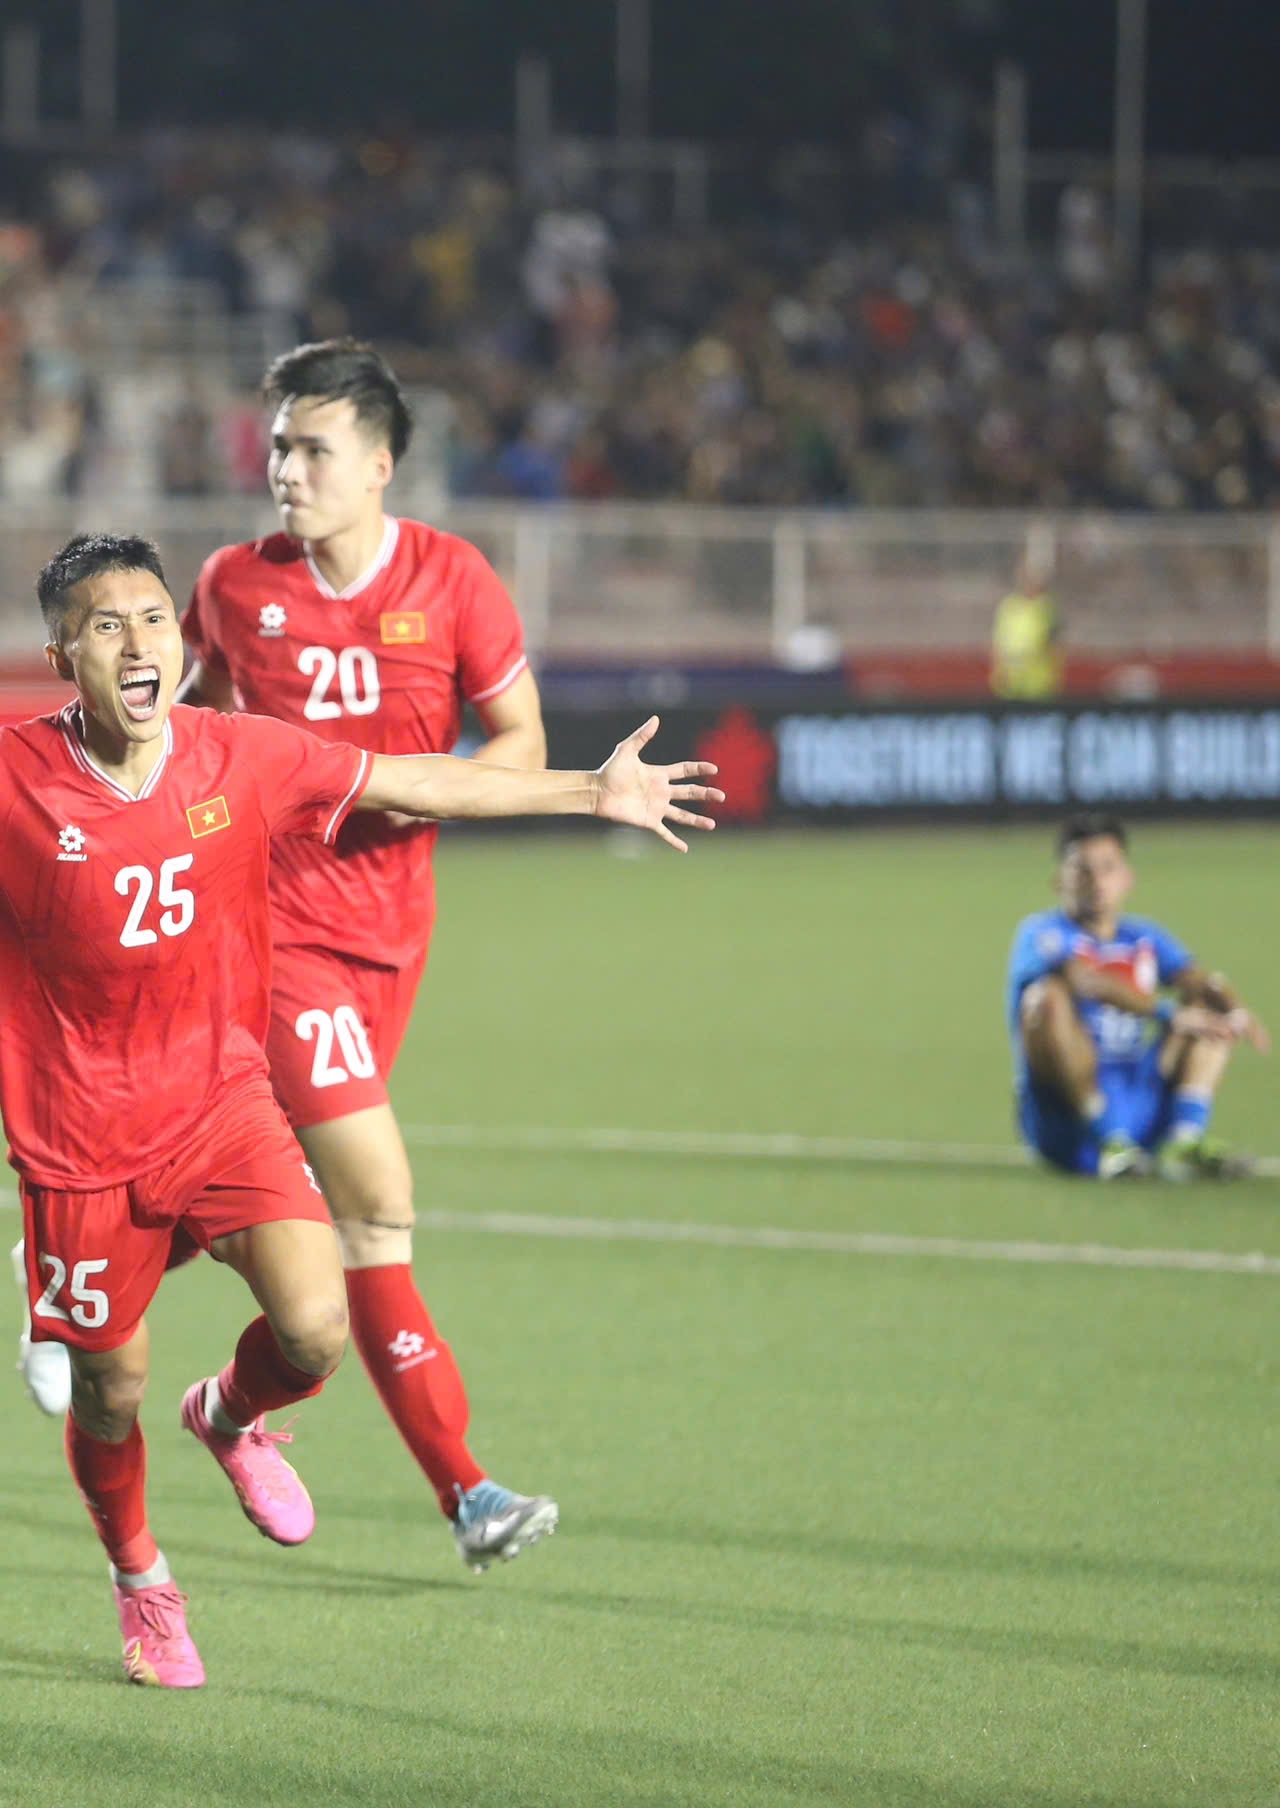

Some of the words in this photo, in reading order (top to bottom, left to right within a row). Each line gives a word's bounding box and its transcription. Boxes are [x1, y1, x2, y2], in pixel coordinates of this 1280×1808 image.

[297, 646, 381, 721] 20
[778, 714, 995, 804] TOGETHER
[1002, 714, 1062, 802] WE
[1068, 713, 1160, 801] CAN
[114, 853, 194, 948] 25
[295, 1005, 375, 1088] 20
[34, 1252, 109, 1328] 25
